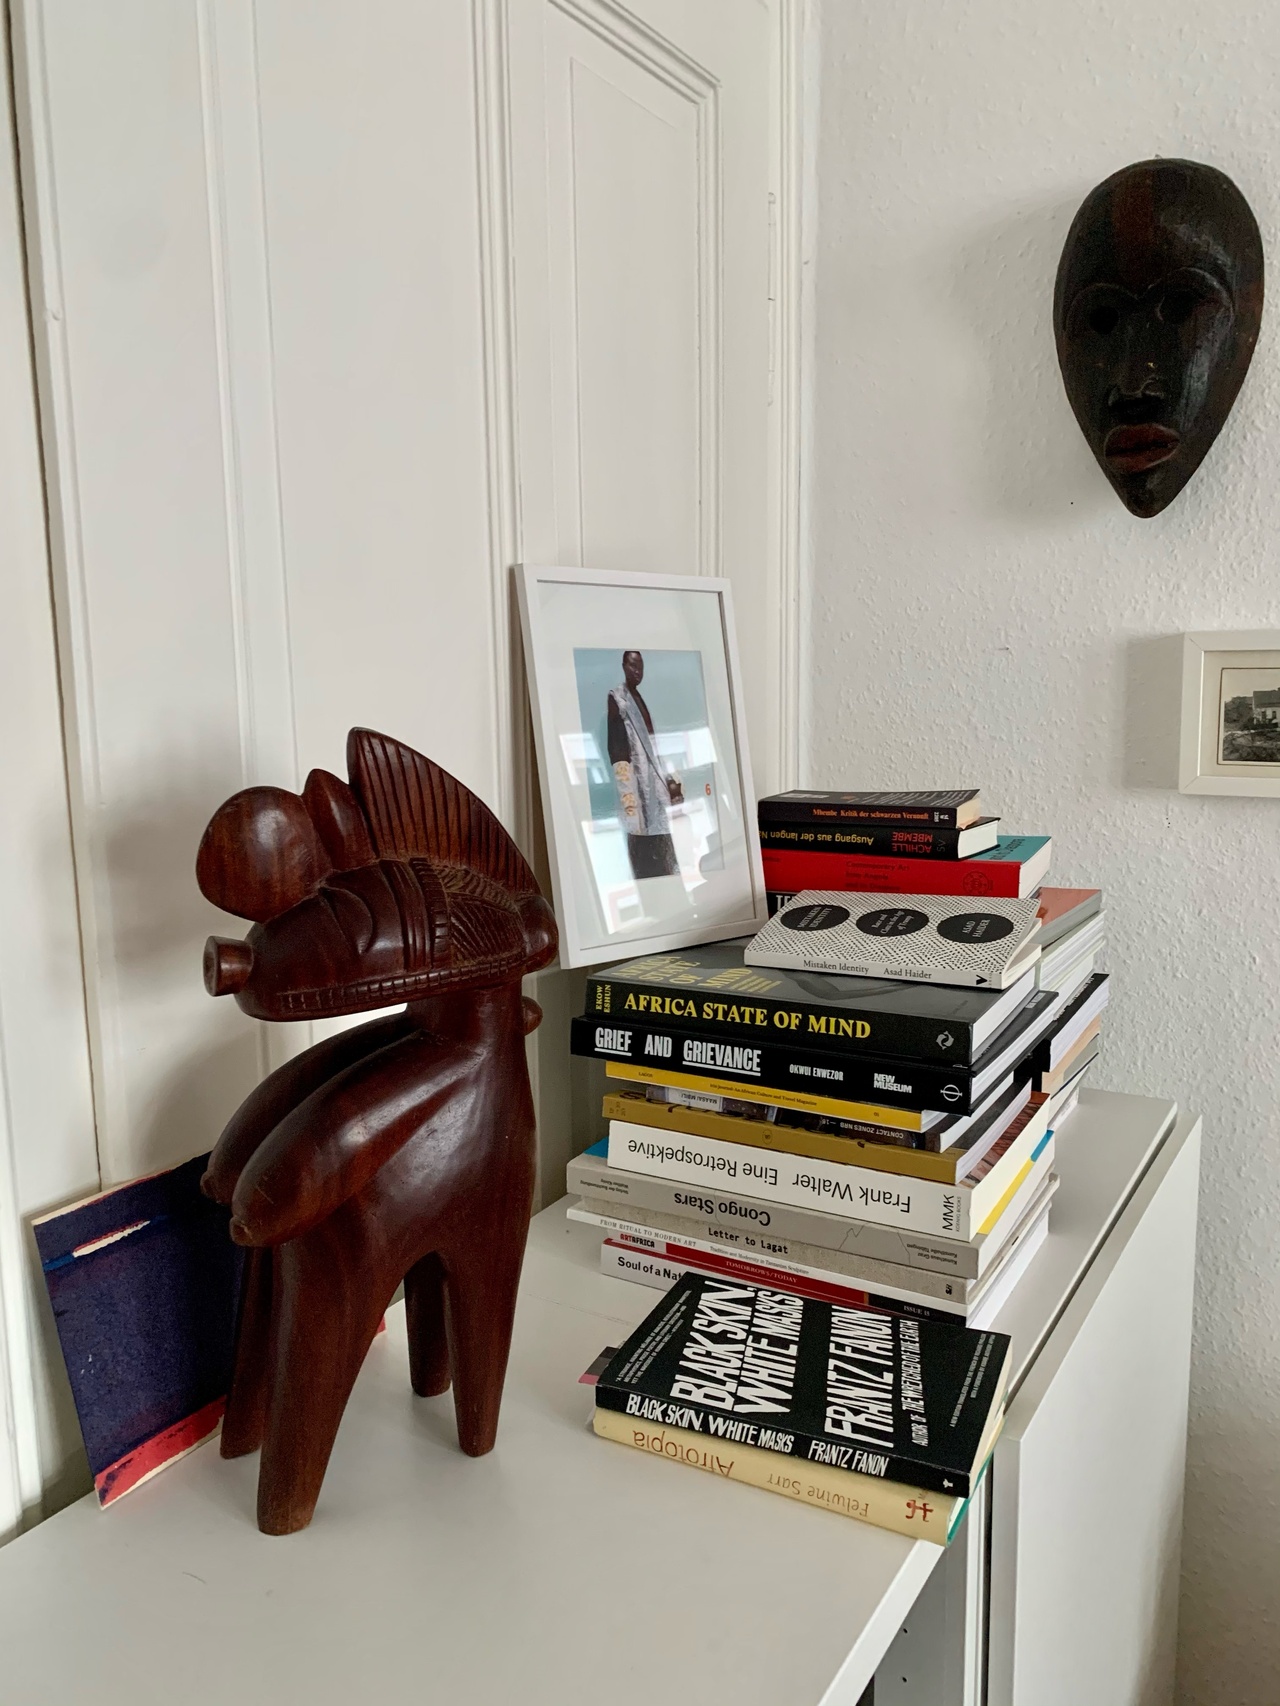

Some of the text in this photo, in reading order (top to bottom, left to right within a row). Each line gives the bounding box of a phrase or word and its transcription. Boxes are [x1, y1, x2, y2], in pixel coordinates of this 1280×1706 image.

[704, 783, 712, 797] 6
[840, 809, 858, 817] Kritik
[859, 810, 869, 818] der
[870, 811, 901, 819] schwarzen
[902, 811, 929, 820] Vernunft
[770, 830, 798, 842] langen
[800, 832, 815, 842] der
[835, 832, 875, 846] Ausgang
[892, 831, 933, 843] MBEMBE
[891, 842, 932, 854] ACHILLE
[697, 968, 753, 989] MIND
[803, 960, 932, 979] Mistaken Identity Asad Haider
[595, 985, 603, 1010] EKOW
[603, 984, 611, 1013] ESHUN
[624, 993, 871, 1039] AFRICA STATE OF MIND
[595, 1027, 844, 1082] GRIEF AND GRIEVANCE OKWUI ENWEZOR
[873, 1072, 895, 1083] NEW
[873, 1081, 912, 1094] MUSEUM
[854, 1124, 875, 1135] ZONES
[876, 1128, 904, 1139] CONTACT
[628, 1139, 911, 1213] Frank Walter Eine Retrospektive
[674, 1192, 771, 1227] Congo Stars
[942, 1194, 954, 1231] MMK
[600, 1219, 617, 1228] FROM
[619, 1222, 642, 1234] RITUAL
[654, 1231, 682, 1243] MODERN
[683, 1239, 697, 1247] ART
[620, 1233, 655, 1248] ARTAFRICA
[708, 1227, 789, 1254] Letter to Lagat
[617, 1256, 641, 1271] Soul
[642, 1264, 654, 1274] of
[655, 1268, 661, 1277] a
[725, 1260, 798, 1283] TOMORROWS/TODAY
[903, 1305, 923, 1316] ISSUE
[899, 1319, 919, 1345] EARTH
[669, 1280, 758, 1411] BLACK SKIN,
[733, 1289, 804, 1414] WHITE MASKS
[824, 1305, 895, 1449] FRANTZ FANON
[901, 1362, 924, 1400] WRETCHED
[901, 1397, 925, 1414] THE
[910, 1413, 927, 1424] OF
[626, 1393, 667, 1422] BLACK
[708, 1415, 759, 1445] WHITE
[757, 1429, 795, 1453] MASKS
[807, 1440, 853, 1468] FRANTZ
[851, 1451, 889, 1478] FANON
[911, 1422, 929, 1447] AUTHOR
[633, 1430, 869, 1518] Felwine Sarr Afrotopia
